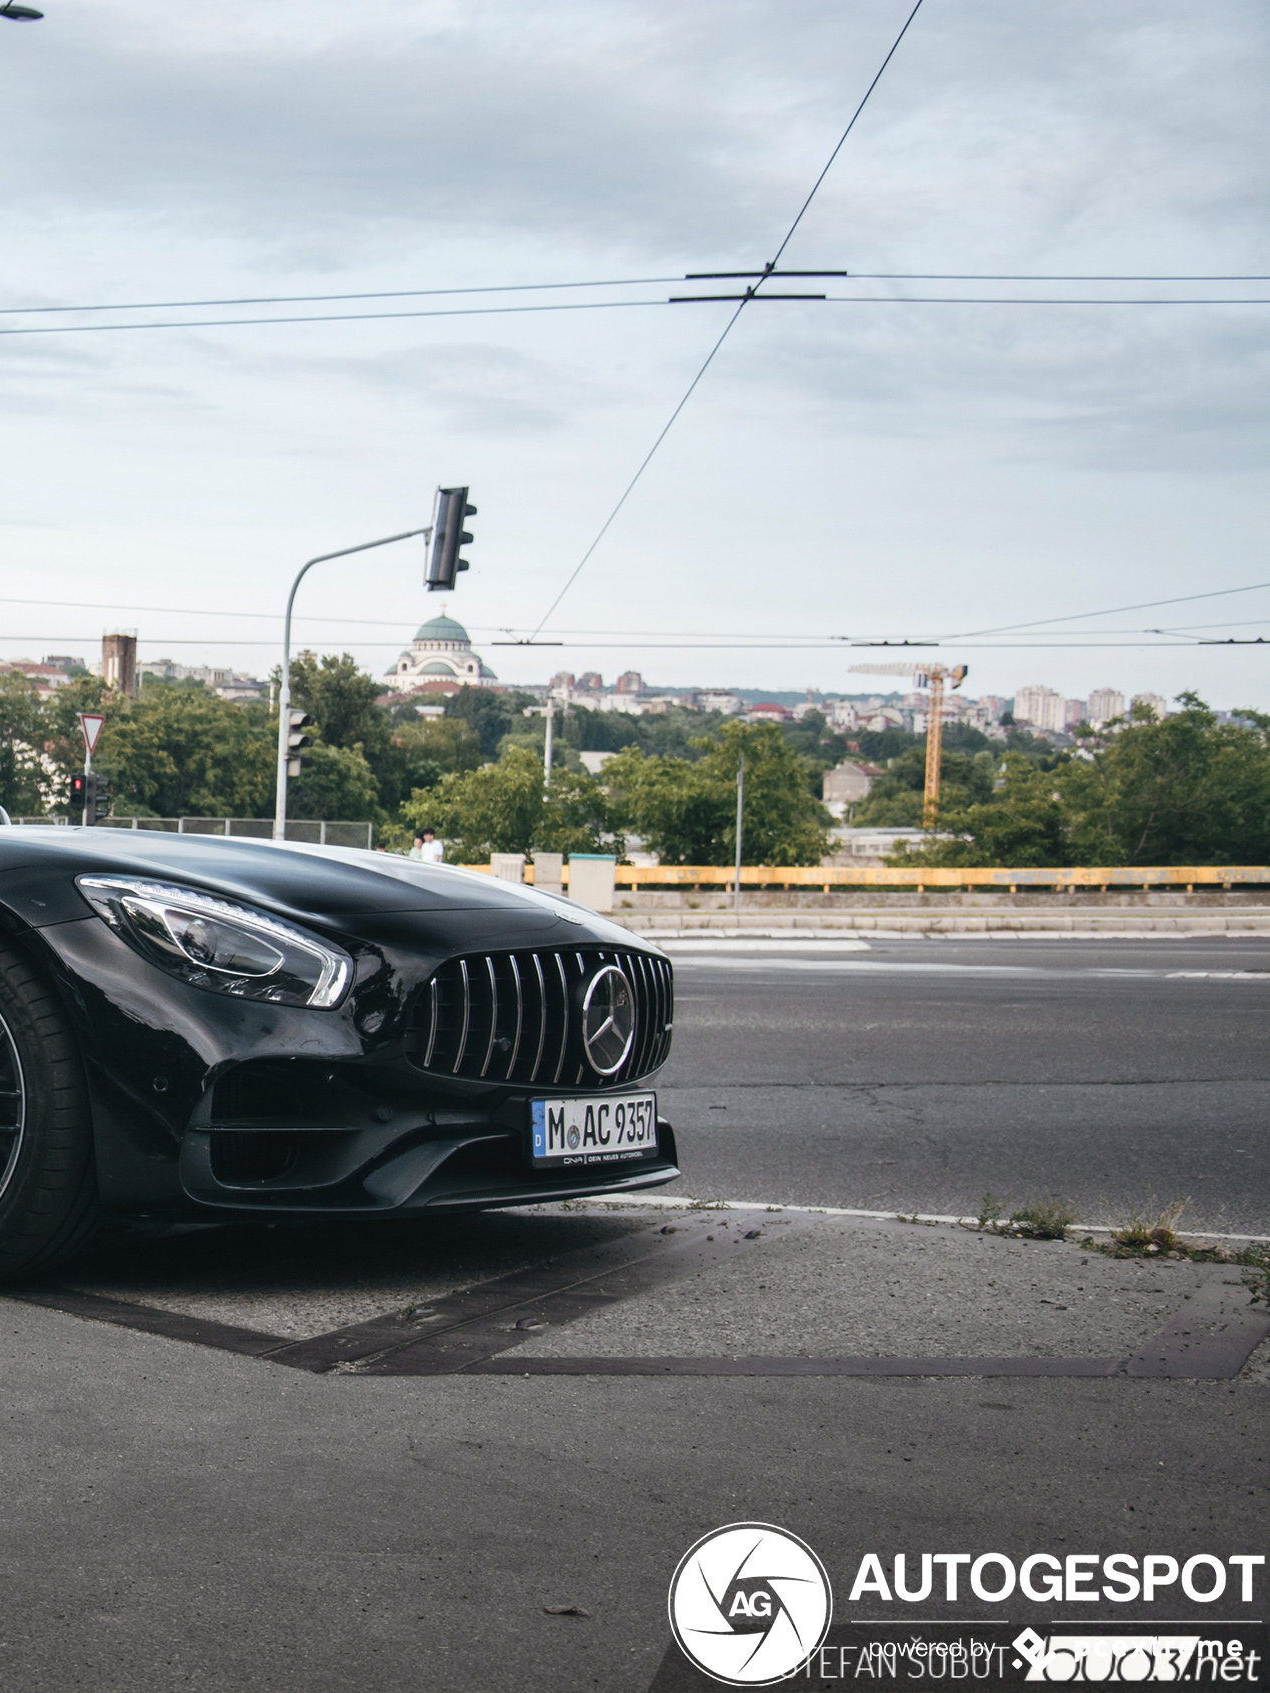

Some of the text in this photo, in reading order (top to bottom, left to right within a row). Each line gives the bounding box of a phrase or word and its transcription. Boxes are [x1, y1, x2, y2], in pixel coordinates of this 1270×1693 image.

[548, 1100, 653, 1149] M AC 9357
[535, 1134, 542, 1147] D
[588, 1155, 602, 1163] DEIN
